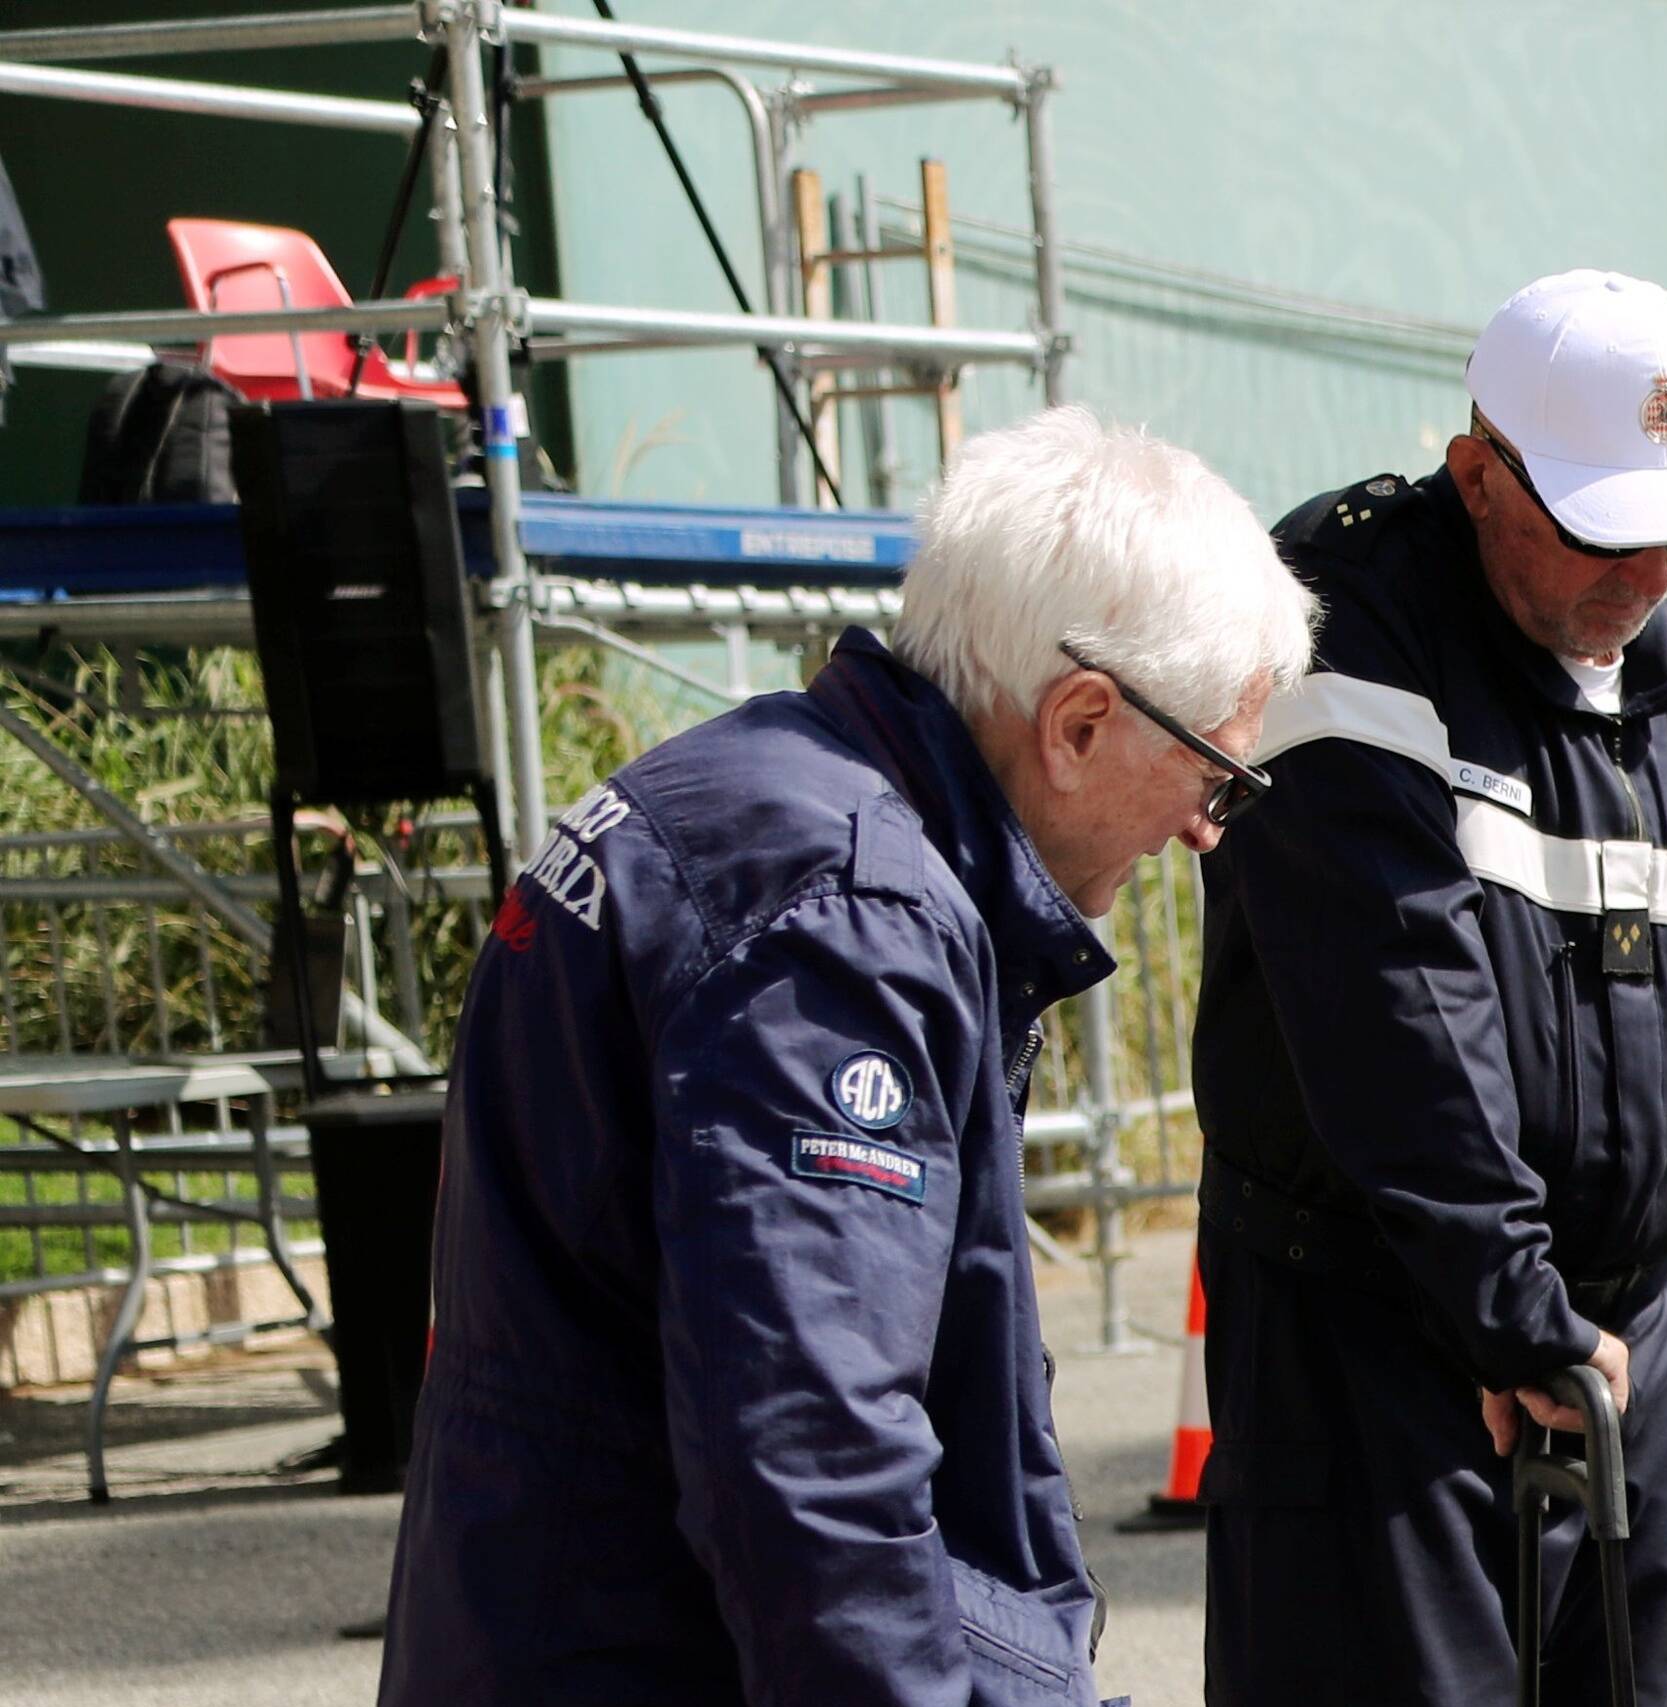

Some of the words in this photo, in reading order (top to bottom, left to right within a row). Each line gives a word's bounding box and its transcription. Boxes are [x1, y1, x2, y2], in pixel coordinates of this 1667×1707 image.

[1459, 768, 1475, 785] C.
[841, 1059, 902, 1121] ACM
[800, 1138, 847, 1158] PETER
